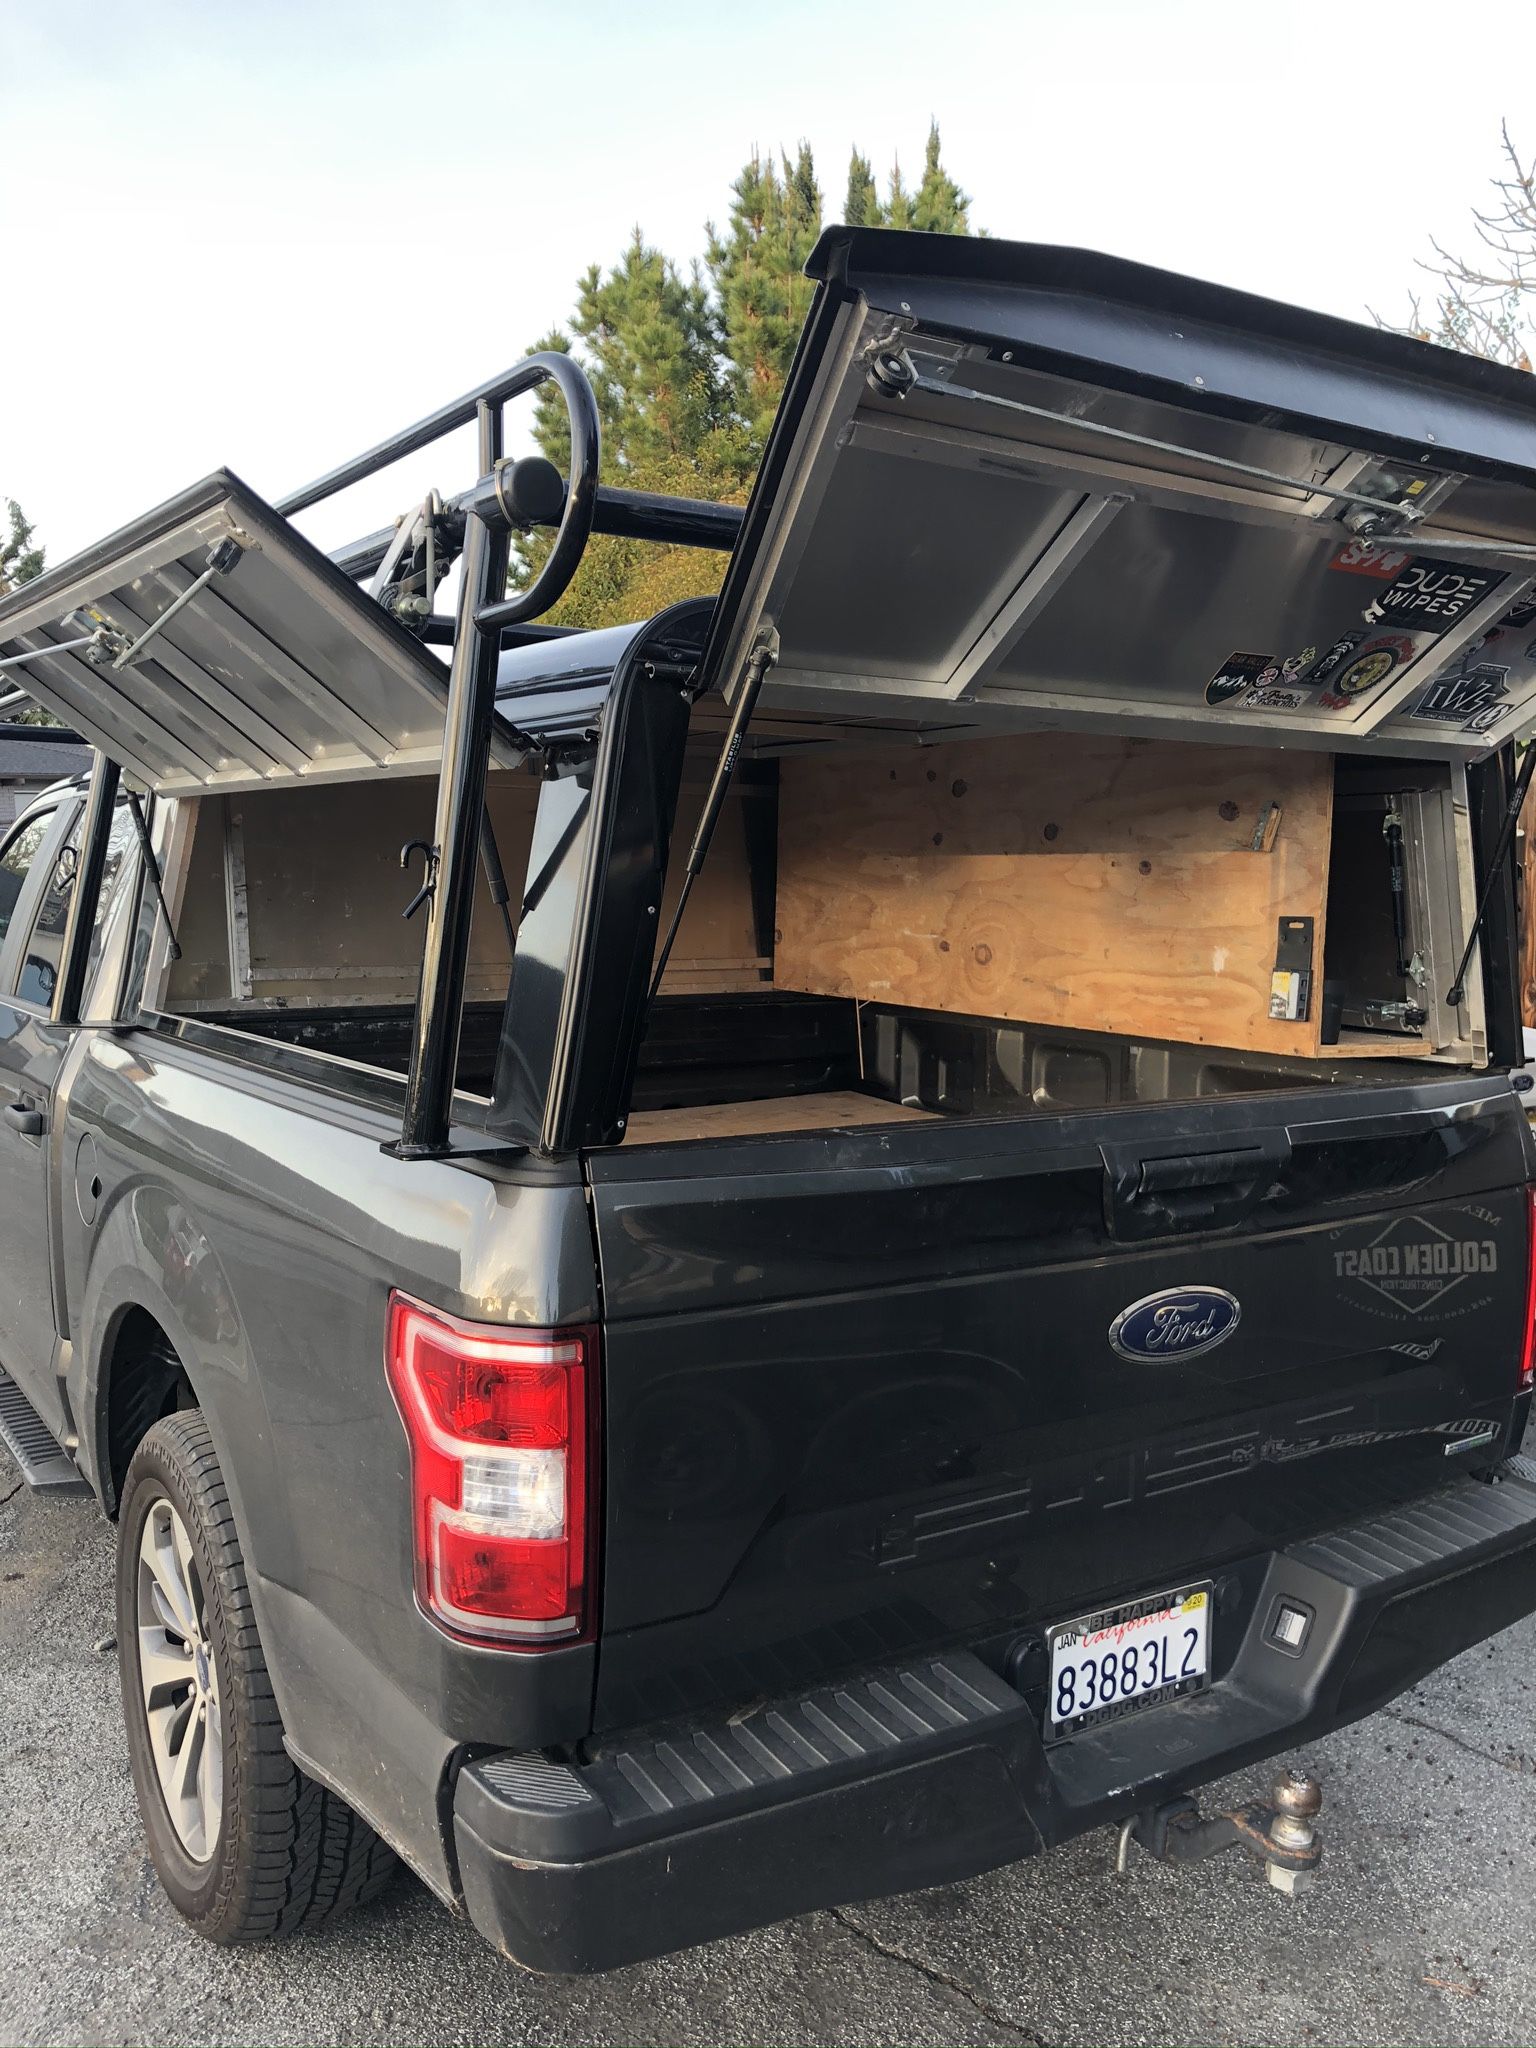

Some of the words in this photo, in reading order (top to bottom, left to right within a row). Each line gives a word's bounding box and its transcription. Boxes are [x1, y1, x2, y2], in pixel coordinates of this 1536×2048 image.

[1383, 589, 1464, 616] WIPES
[1396, 567, 1487, 600] DUDE
[724, 733, 740, 771] STABILUS
[1146, 1303, 1216, 1349] Ford
[1091, 1612, 1114, 1631] BE
[1119, 1593, 1174, 1623] HAPPY
[1192, 1594, 1202, 1605] 20
[1058, 1633, 1077, 1650] JAN
[1056, 1627, 1198, 1717] 83883L2
[1086, 1685, 1175, 1726] DGDG.COM
